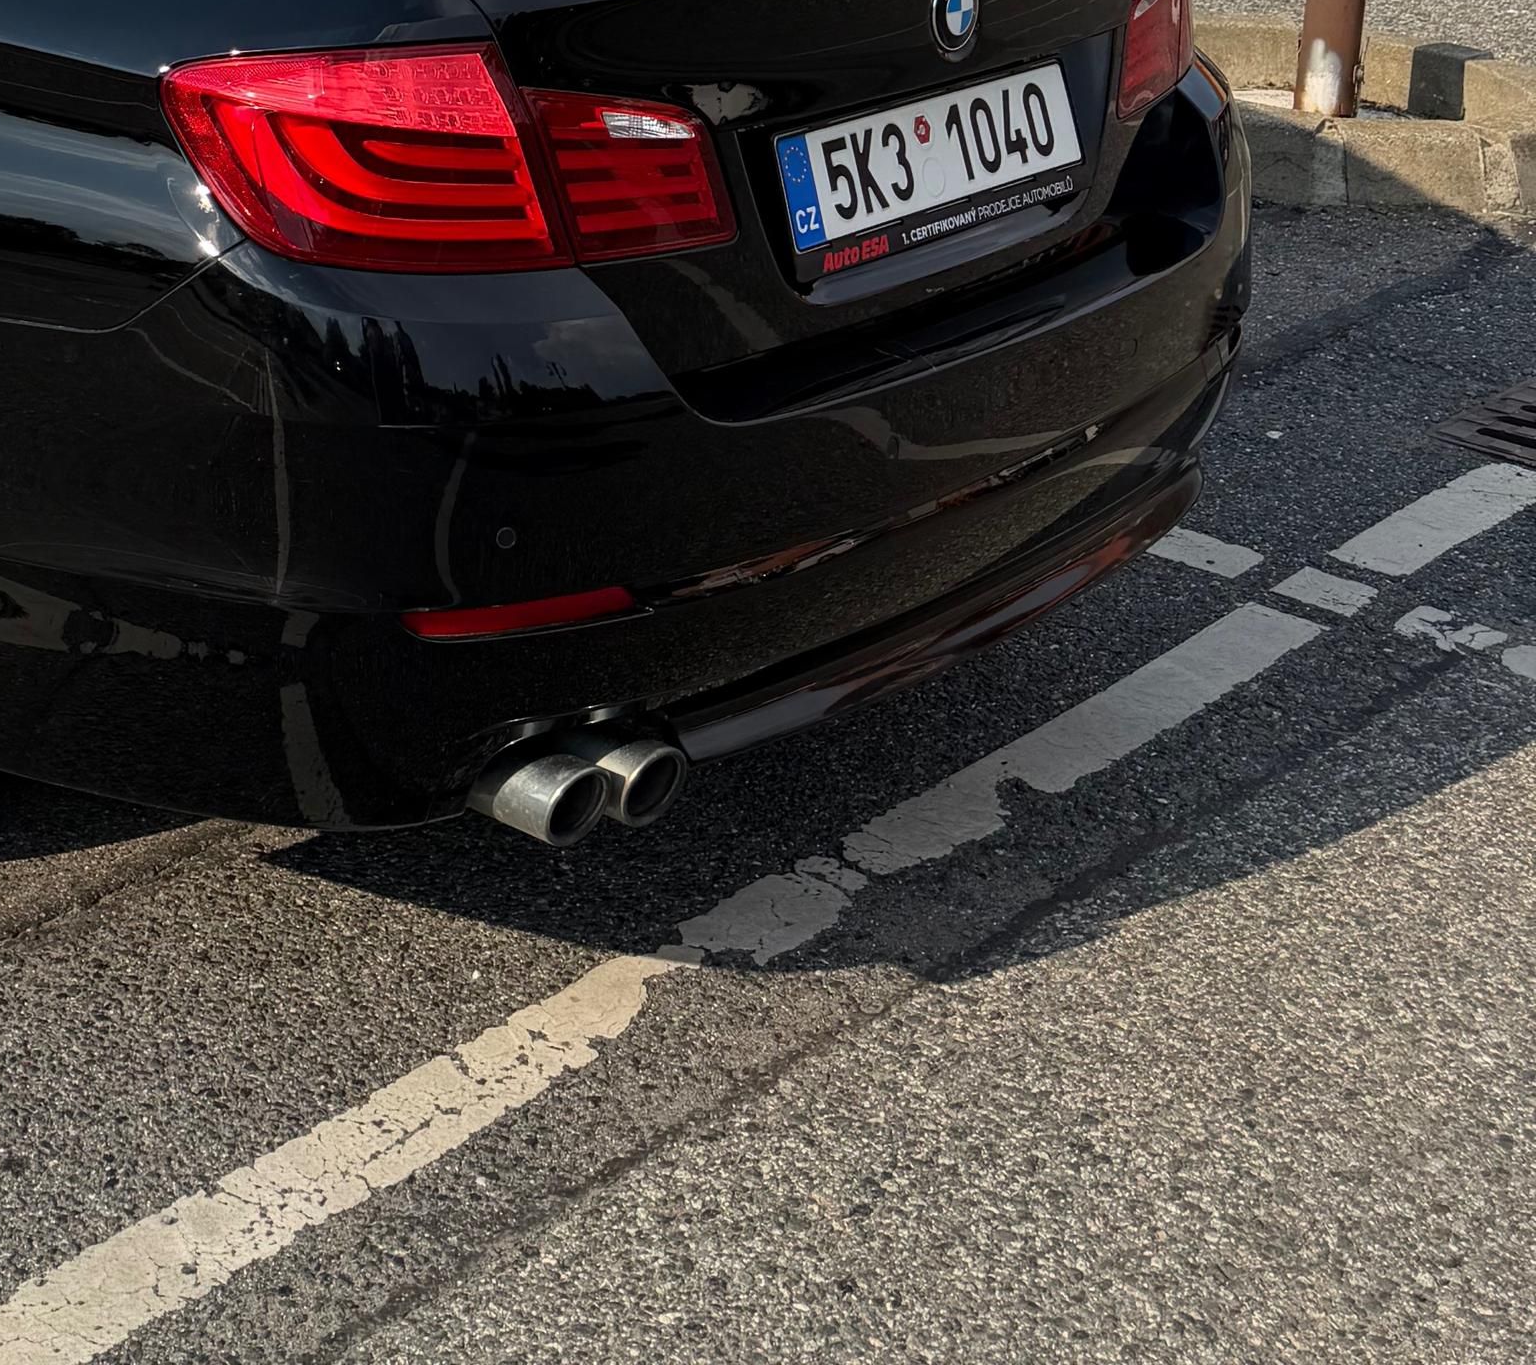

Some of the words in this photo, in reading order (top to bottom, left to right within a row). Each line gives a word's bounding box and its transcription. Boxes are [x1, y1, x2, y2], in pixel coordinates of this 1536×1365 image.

[822, 123, 915, 219] 5K3
[945, 82, 1055, 181] 1040
[795, 205, 820, 235] CZ
[901, 232, 910, 245] 1.
[910, 207, 977, 243] CERTIFIKOVANÝ
[978, 194, 1023, 221] PRODEJCE
[1022, 175, 1074, 207] AUTOMOBILŮ
[823, 245, 860, 273] Auto
[862, 234, 890, 260] ESA
